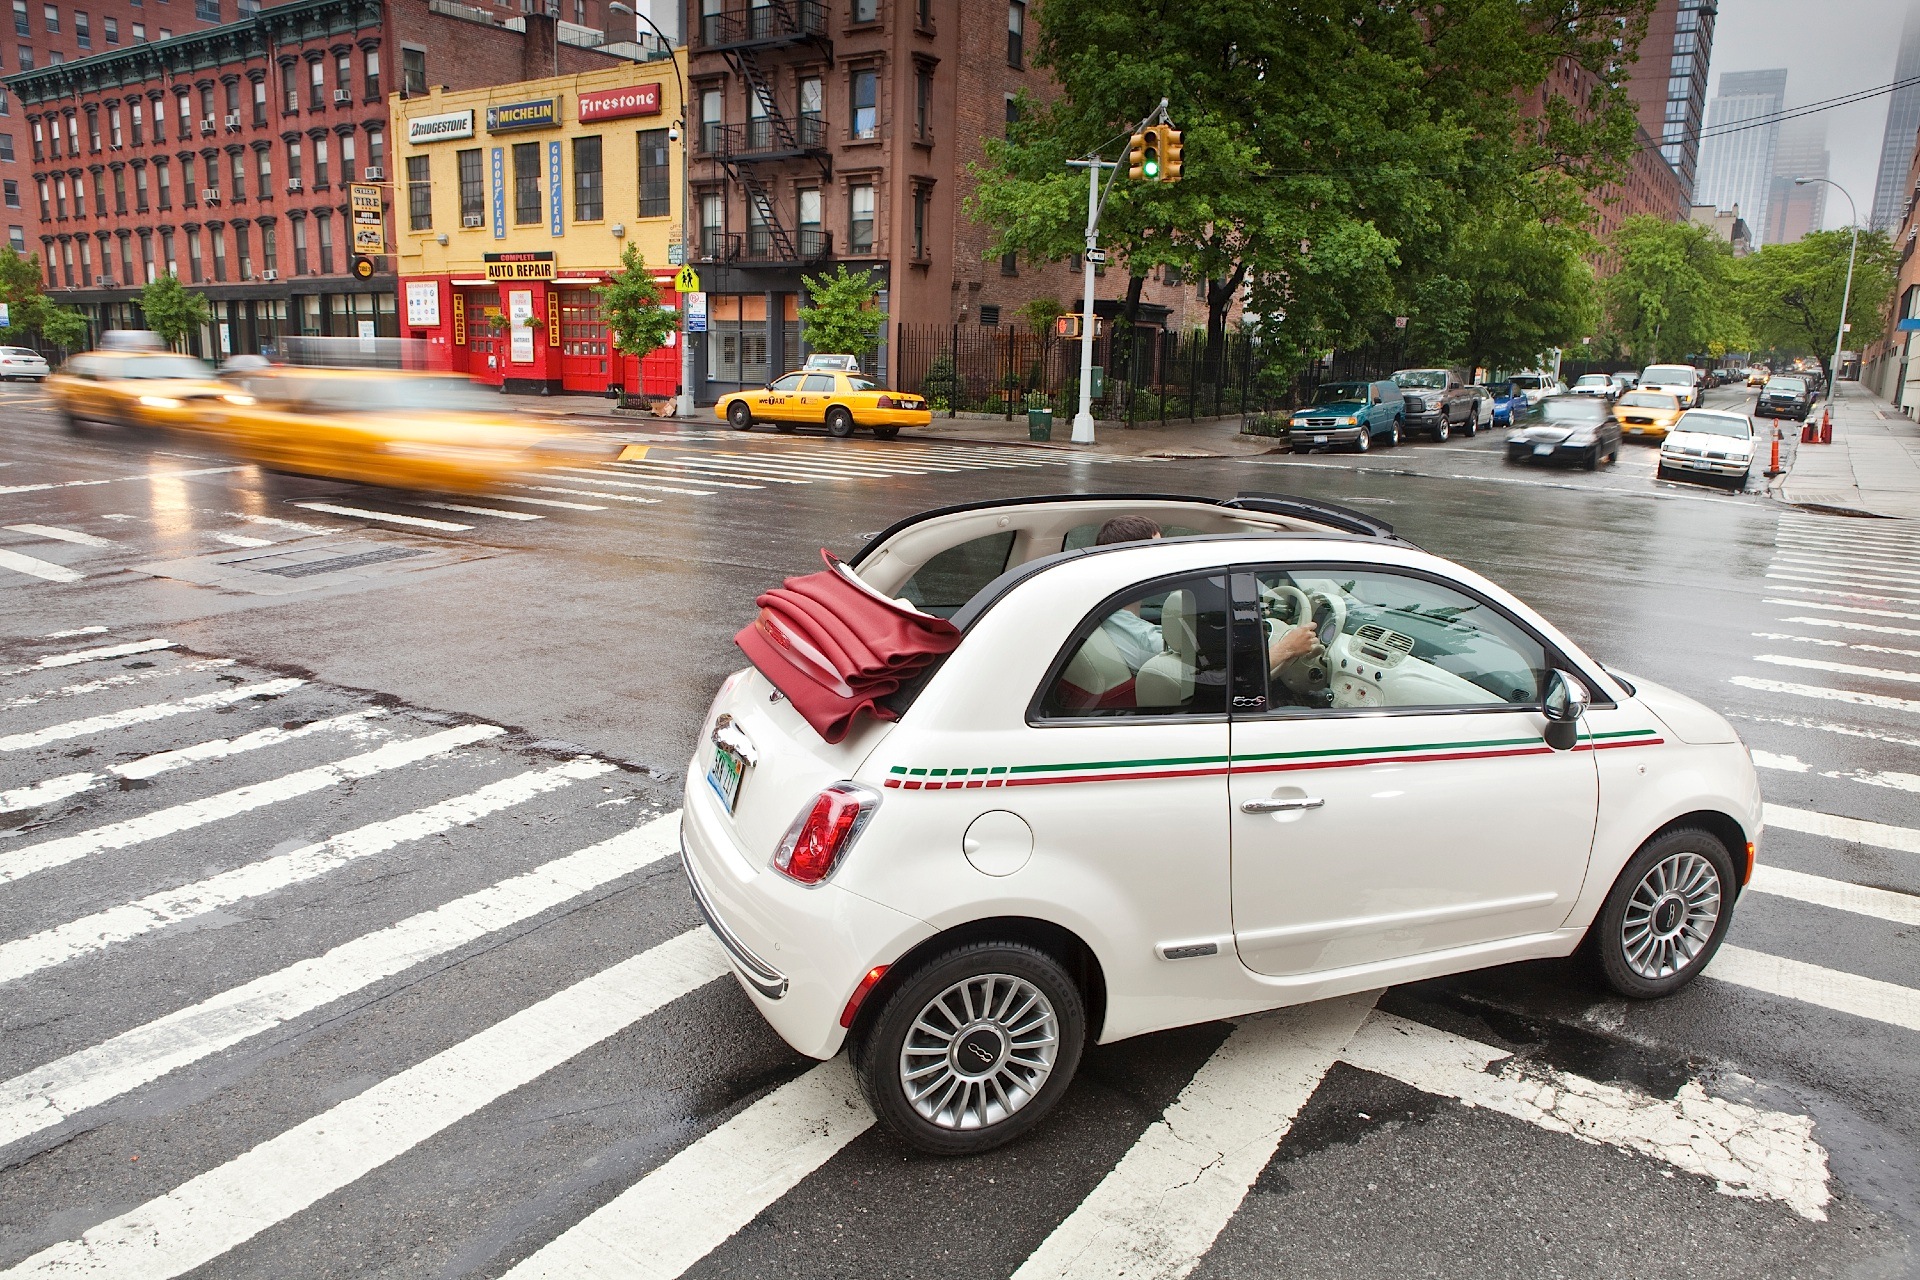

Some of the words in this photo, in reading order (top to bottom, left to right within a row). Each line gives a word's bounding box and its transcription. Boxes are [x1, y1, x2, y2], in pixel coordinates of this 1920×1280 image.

[500, 104, 552, 122] MICHELIN
[580, 91, 655, 117] Firestone
[411, 117, 468, 137] BRIDGESTONE
[493, 151, 503, 236] GOODYEAR
[551, 145, 561, 234] GOODYEAR
[354, 196, 380, 208] TIRE
[500, 253, 535, 262] COMPLETE
[488, 264, 513, 278] AUTO
[517, 263, 551, 277] REPAIR
[549, 293, 558, 344] BRAKES
